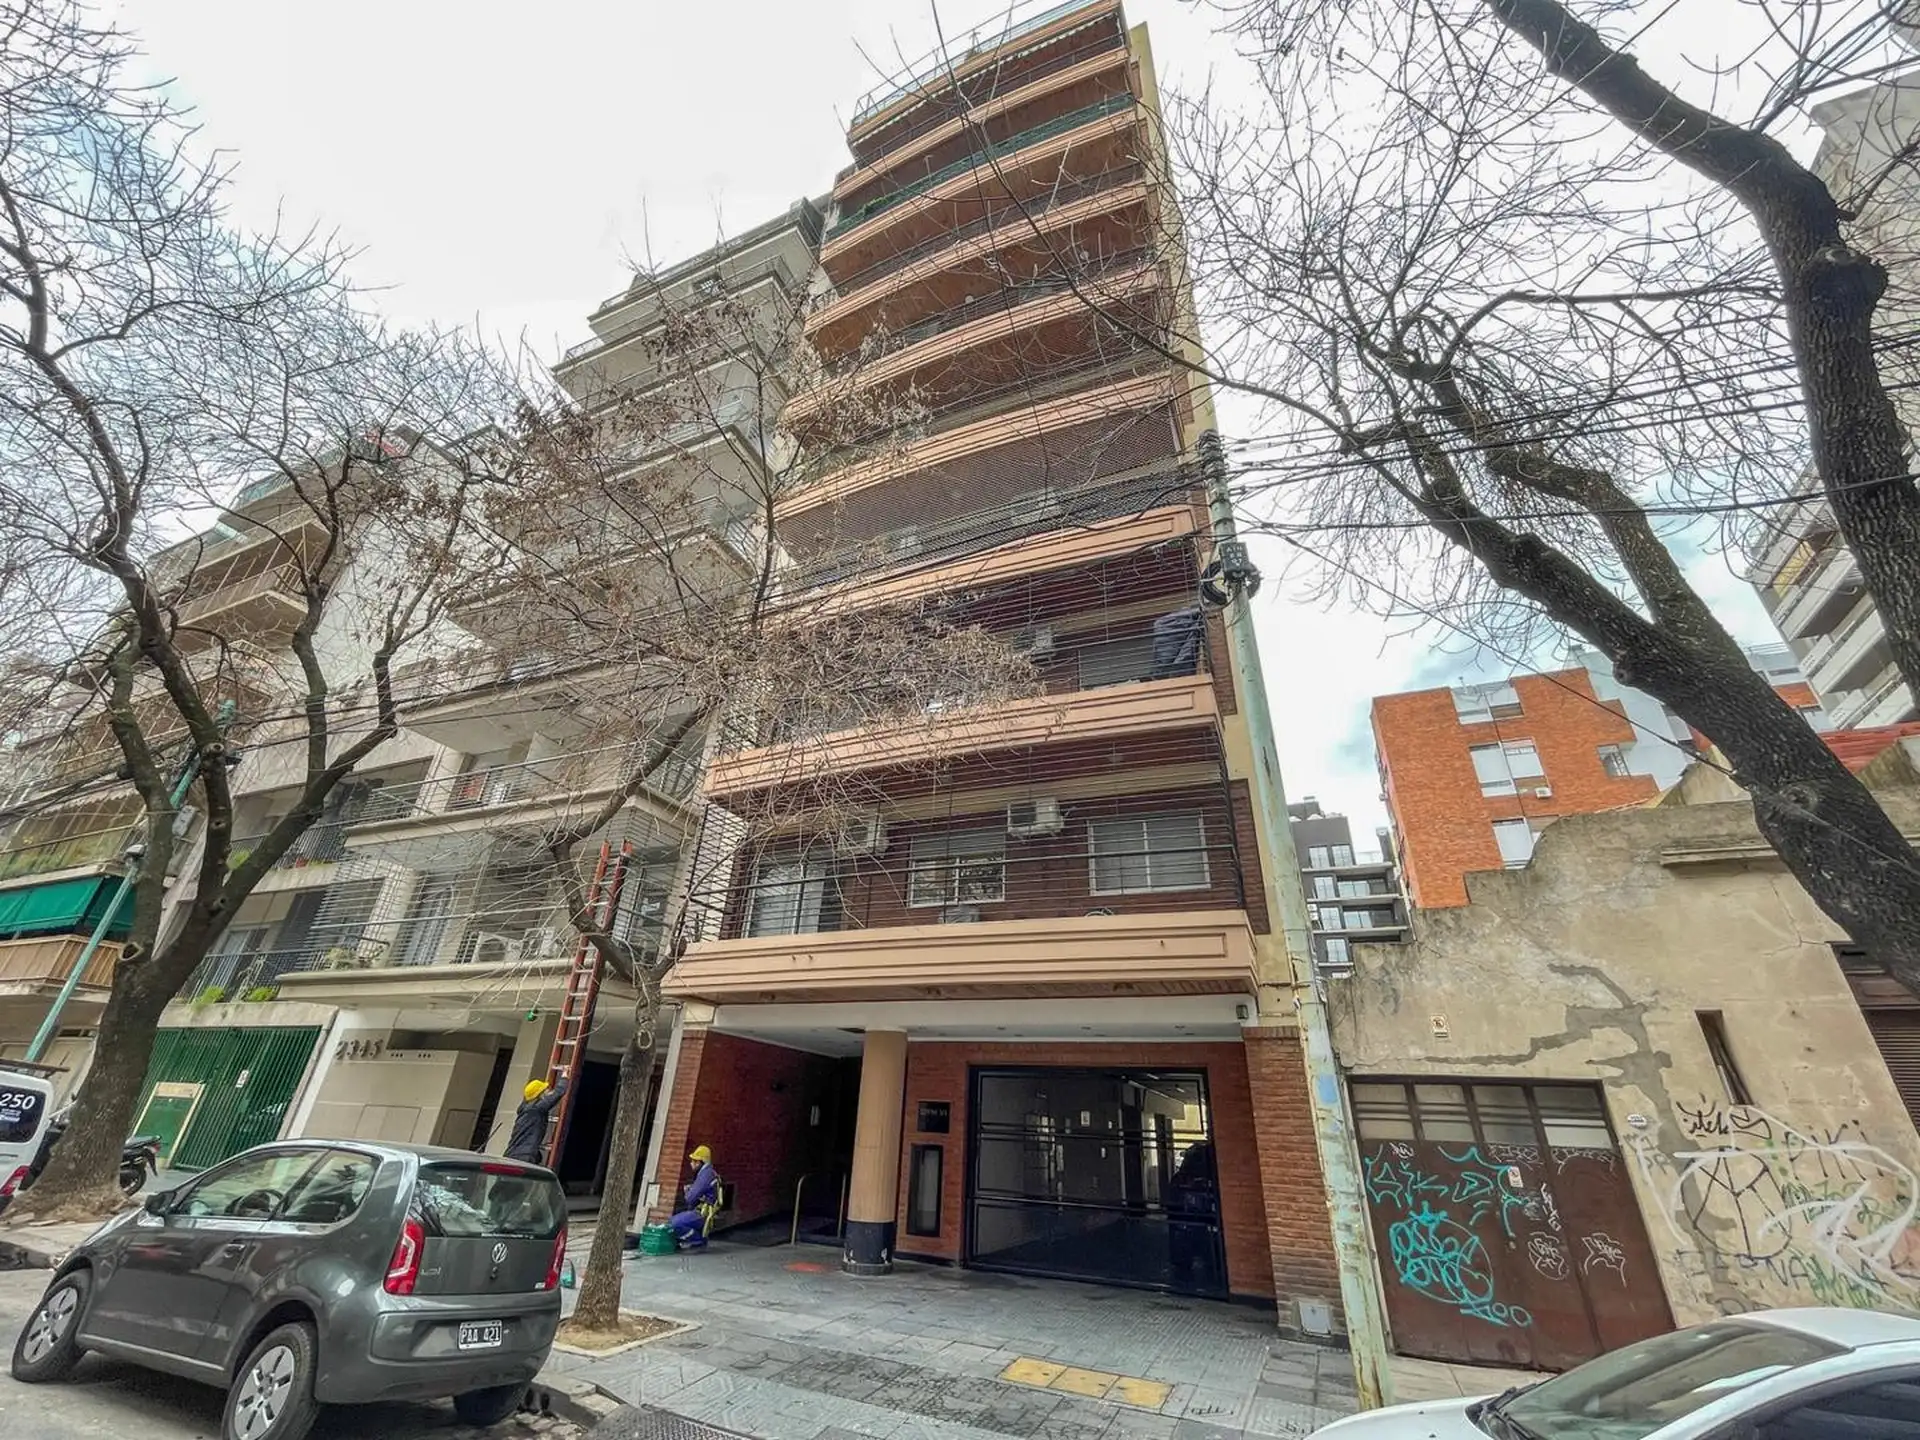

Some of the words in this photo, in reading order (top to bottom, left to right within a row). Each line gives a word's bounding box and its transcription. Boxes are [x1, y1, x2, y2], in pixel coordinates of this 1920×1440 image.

[336, 1039, 383, 1061] 2345
[0, 1093, 35, 1110] 250
[483, 1327, 500, 1341] 421
